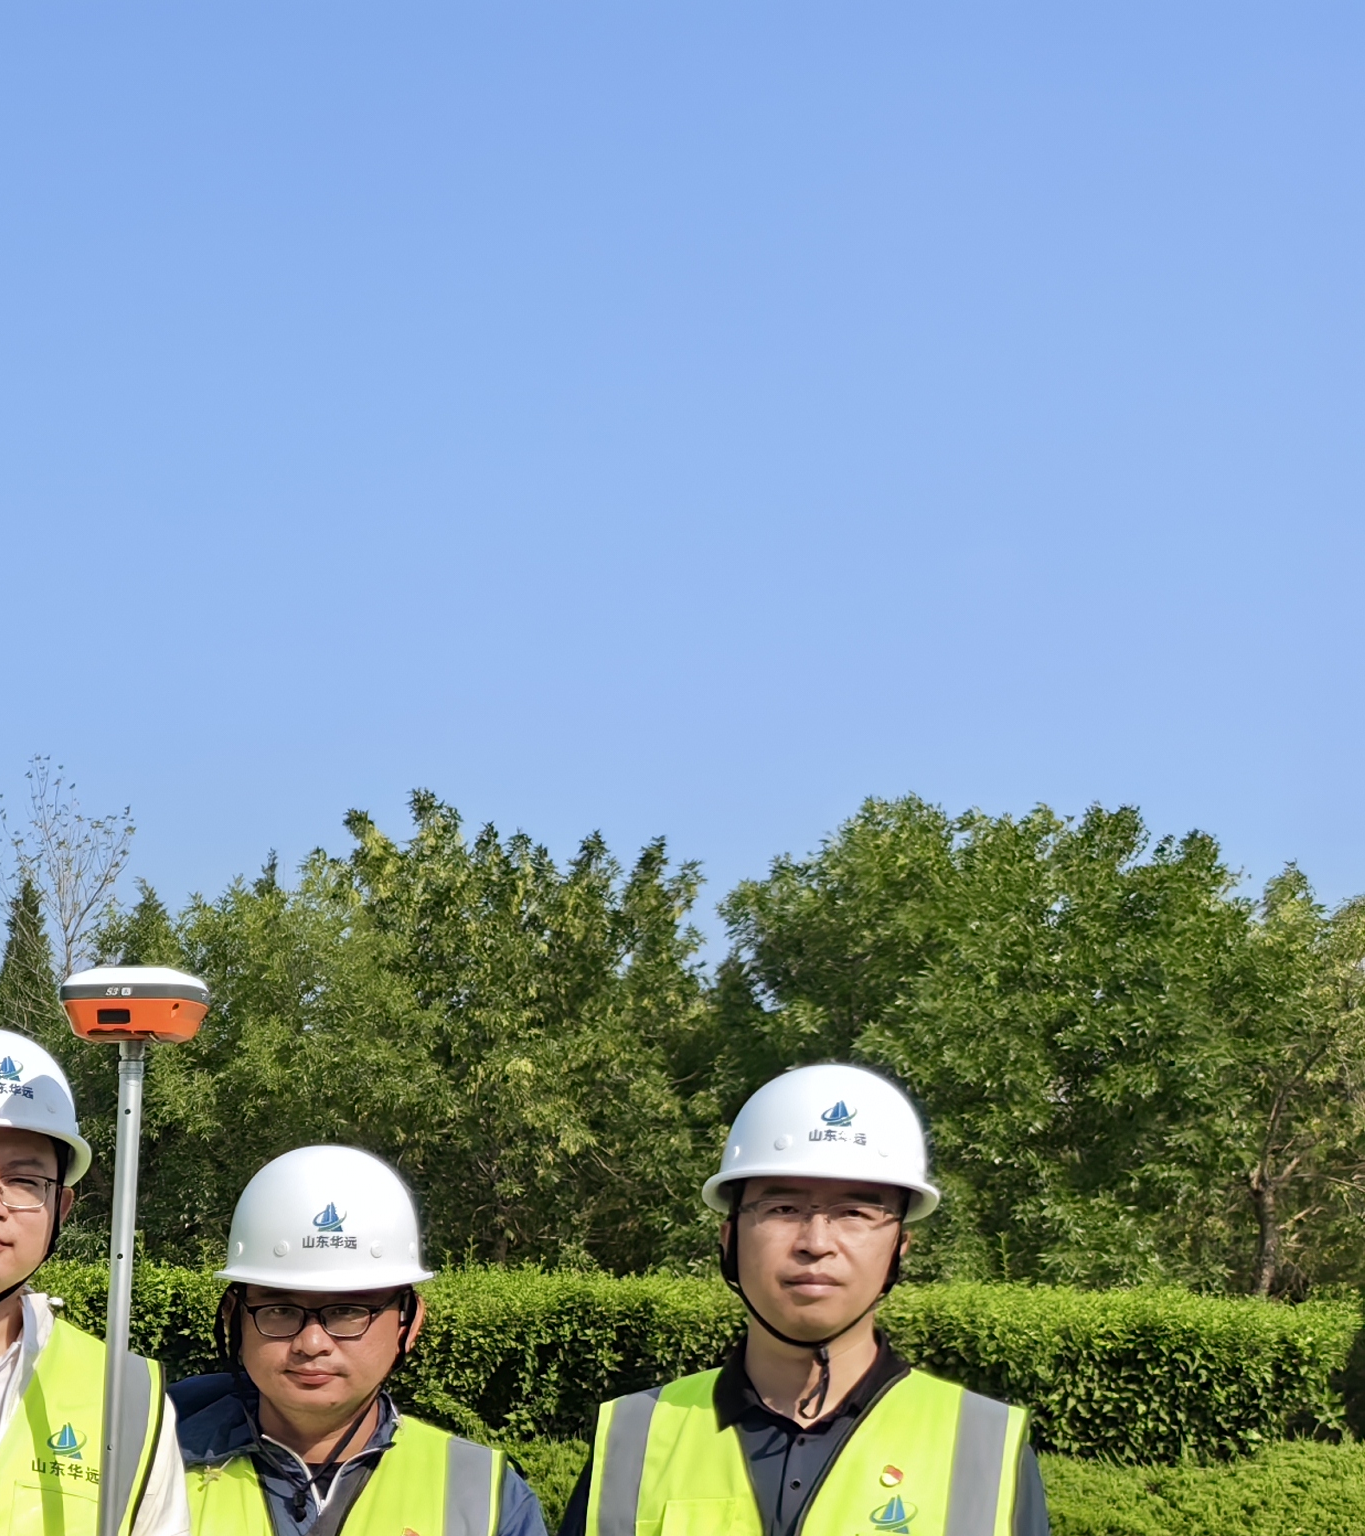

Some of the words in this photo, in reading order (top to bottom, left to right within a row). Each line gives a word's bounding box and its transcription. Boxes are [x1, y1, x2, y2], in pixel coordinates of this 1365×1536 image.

[302, 1235, 357, 1250] 山东华远
[31, 1458, 100, 1485] 山东华远
